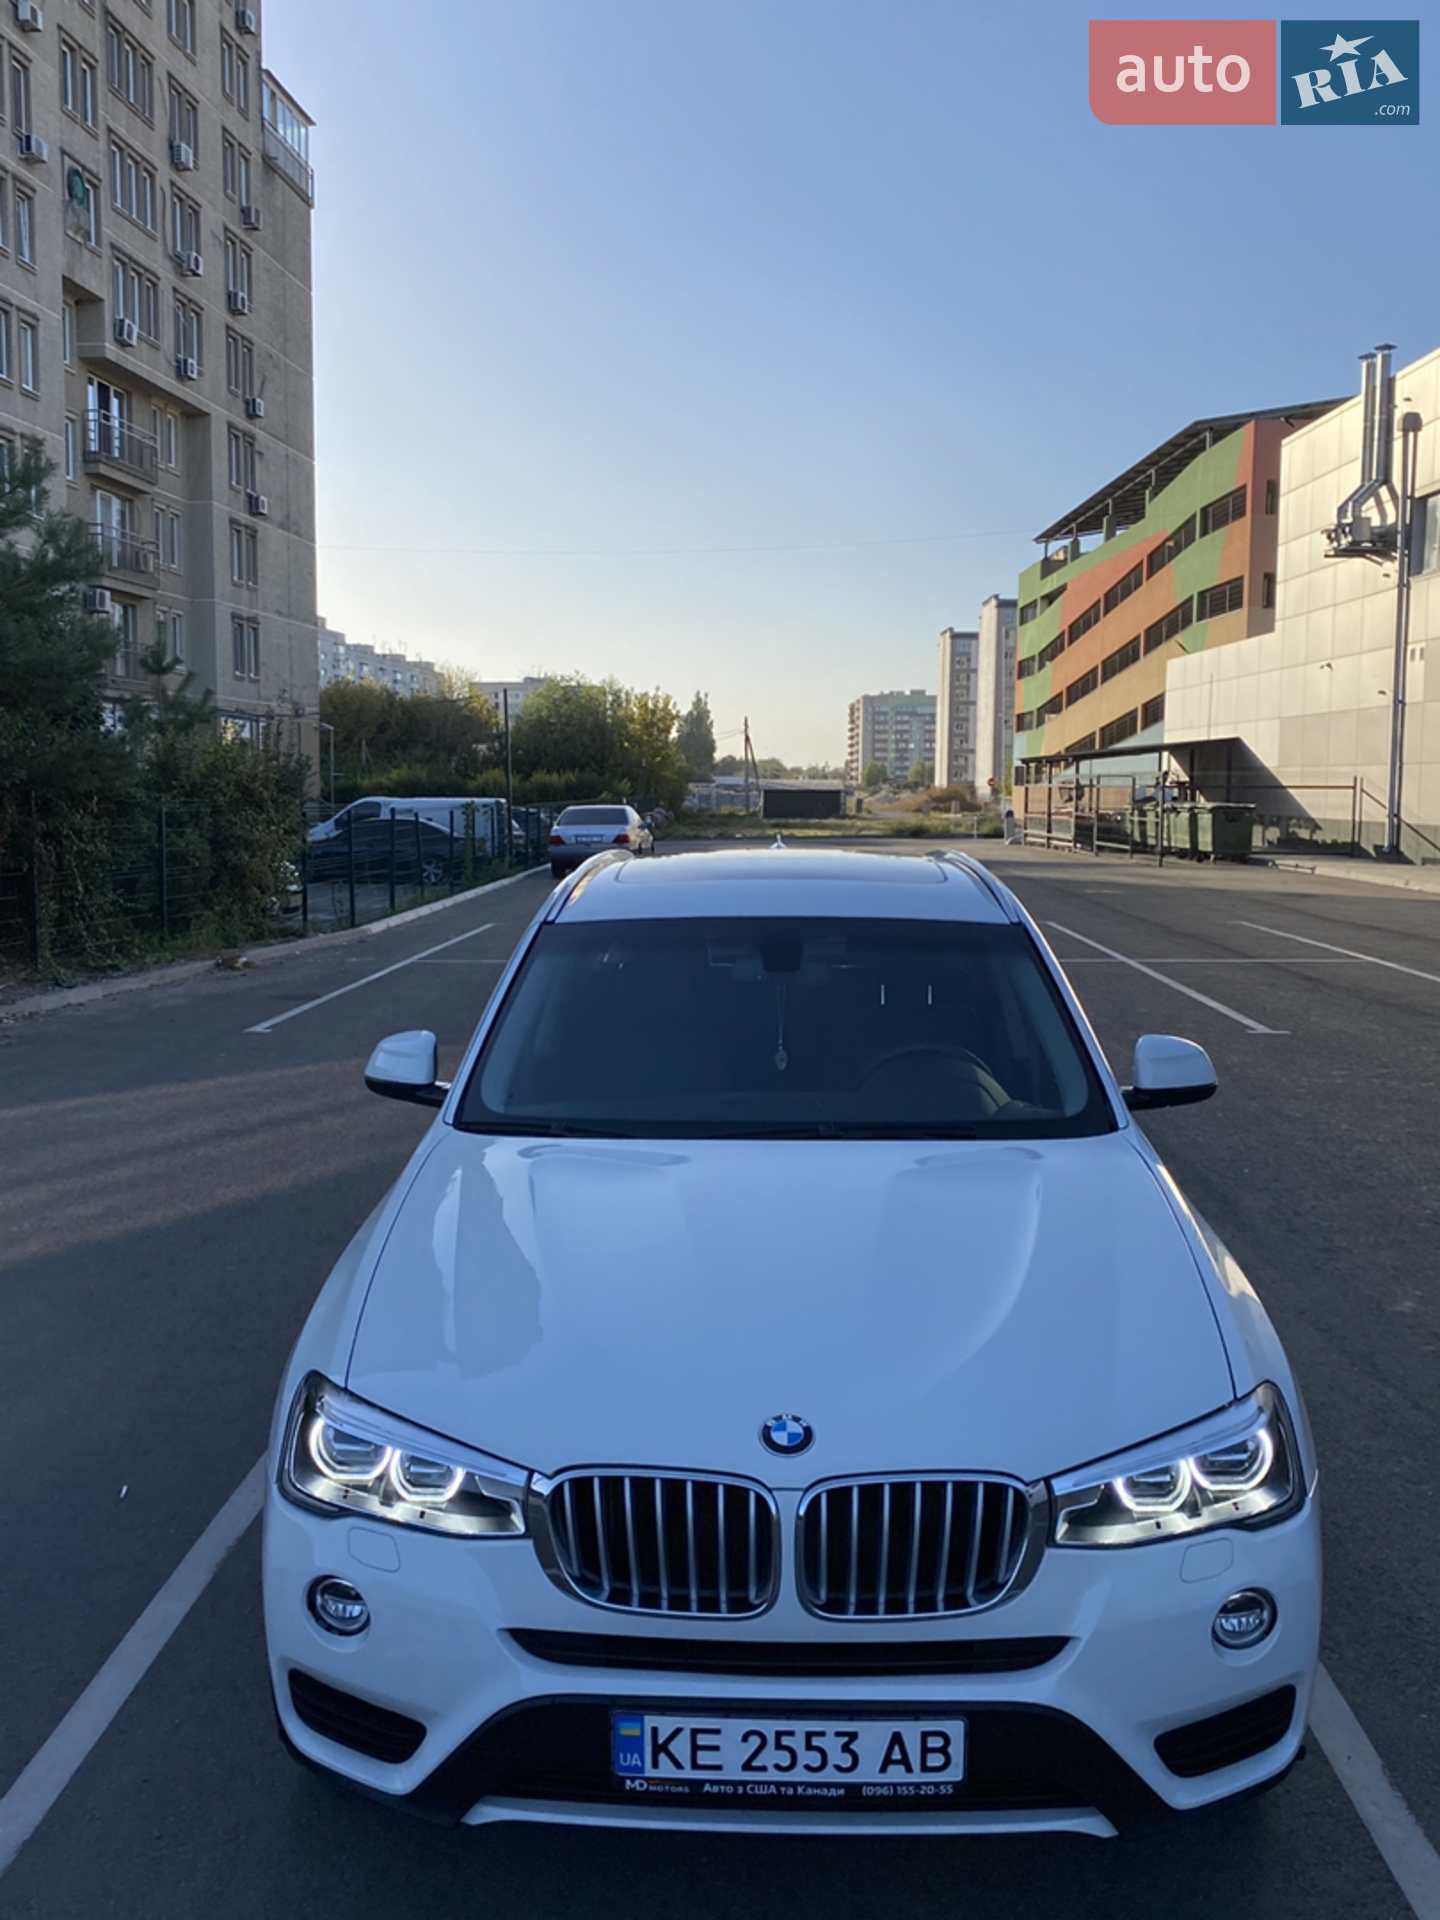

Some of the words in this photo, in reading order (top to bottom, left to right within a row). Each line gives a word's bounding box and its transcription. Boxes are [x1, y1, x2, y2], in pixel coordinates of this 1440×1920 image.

[650, 1726, 723, 1771] KE
[740, 1729, 860, 1774] 2553
[877, 1731, 952, 1774] AB
[619, 1752, 642, 1767] UA
[703, 1782, 734, 1794] Авто
[746, 1783, 777, 1795] США
[779, 1785, 794, 1796] та
[797, 1785, 845, 1797] Канади
[861, 1785, 894, 1797] (096)
[895, 1784, 954, 1796] 155-20-55
